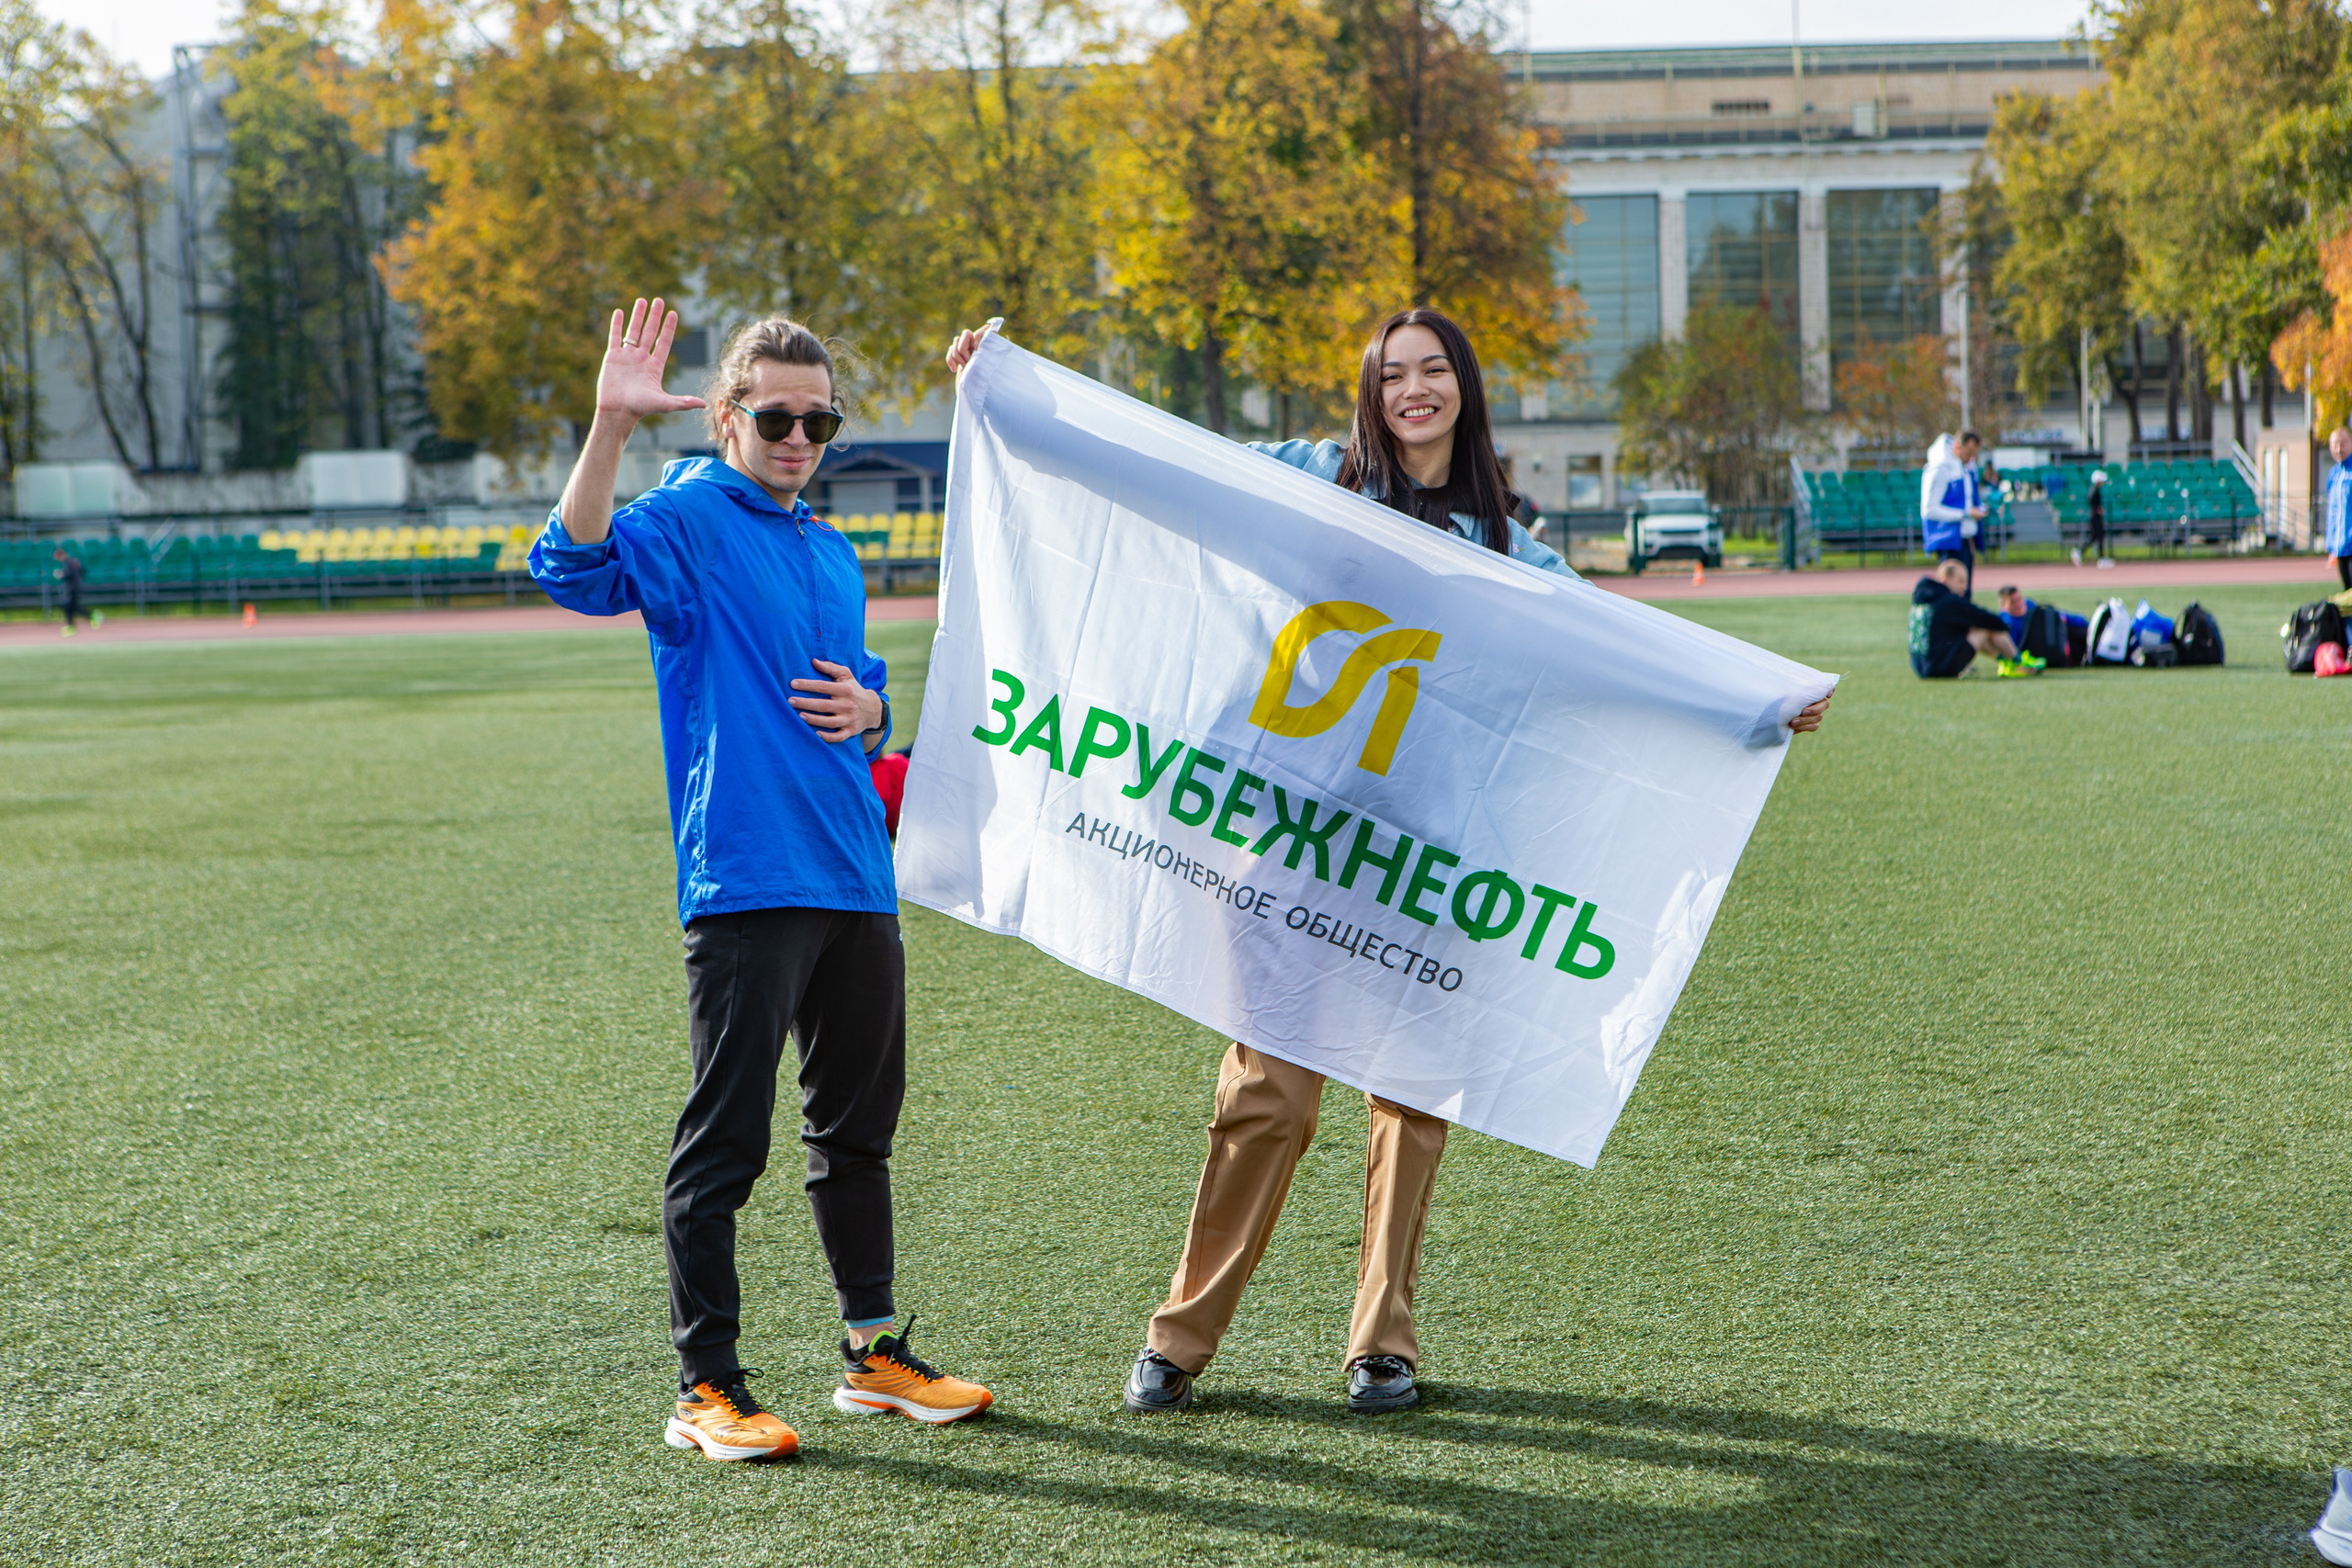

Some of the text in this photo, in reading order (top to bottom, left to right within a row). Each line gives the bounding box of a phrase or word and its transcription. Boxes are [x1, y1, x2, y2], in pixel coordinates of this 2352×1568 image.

[971, 668, 1616, 980] ЗАРУБЕЖНЕФТЬ
[1065, 812, 1464, 993] АКЦИОНЕРНОЕ ОБЩЕСТВО
